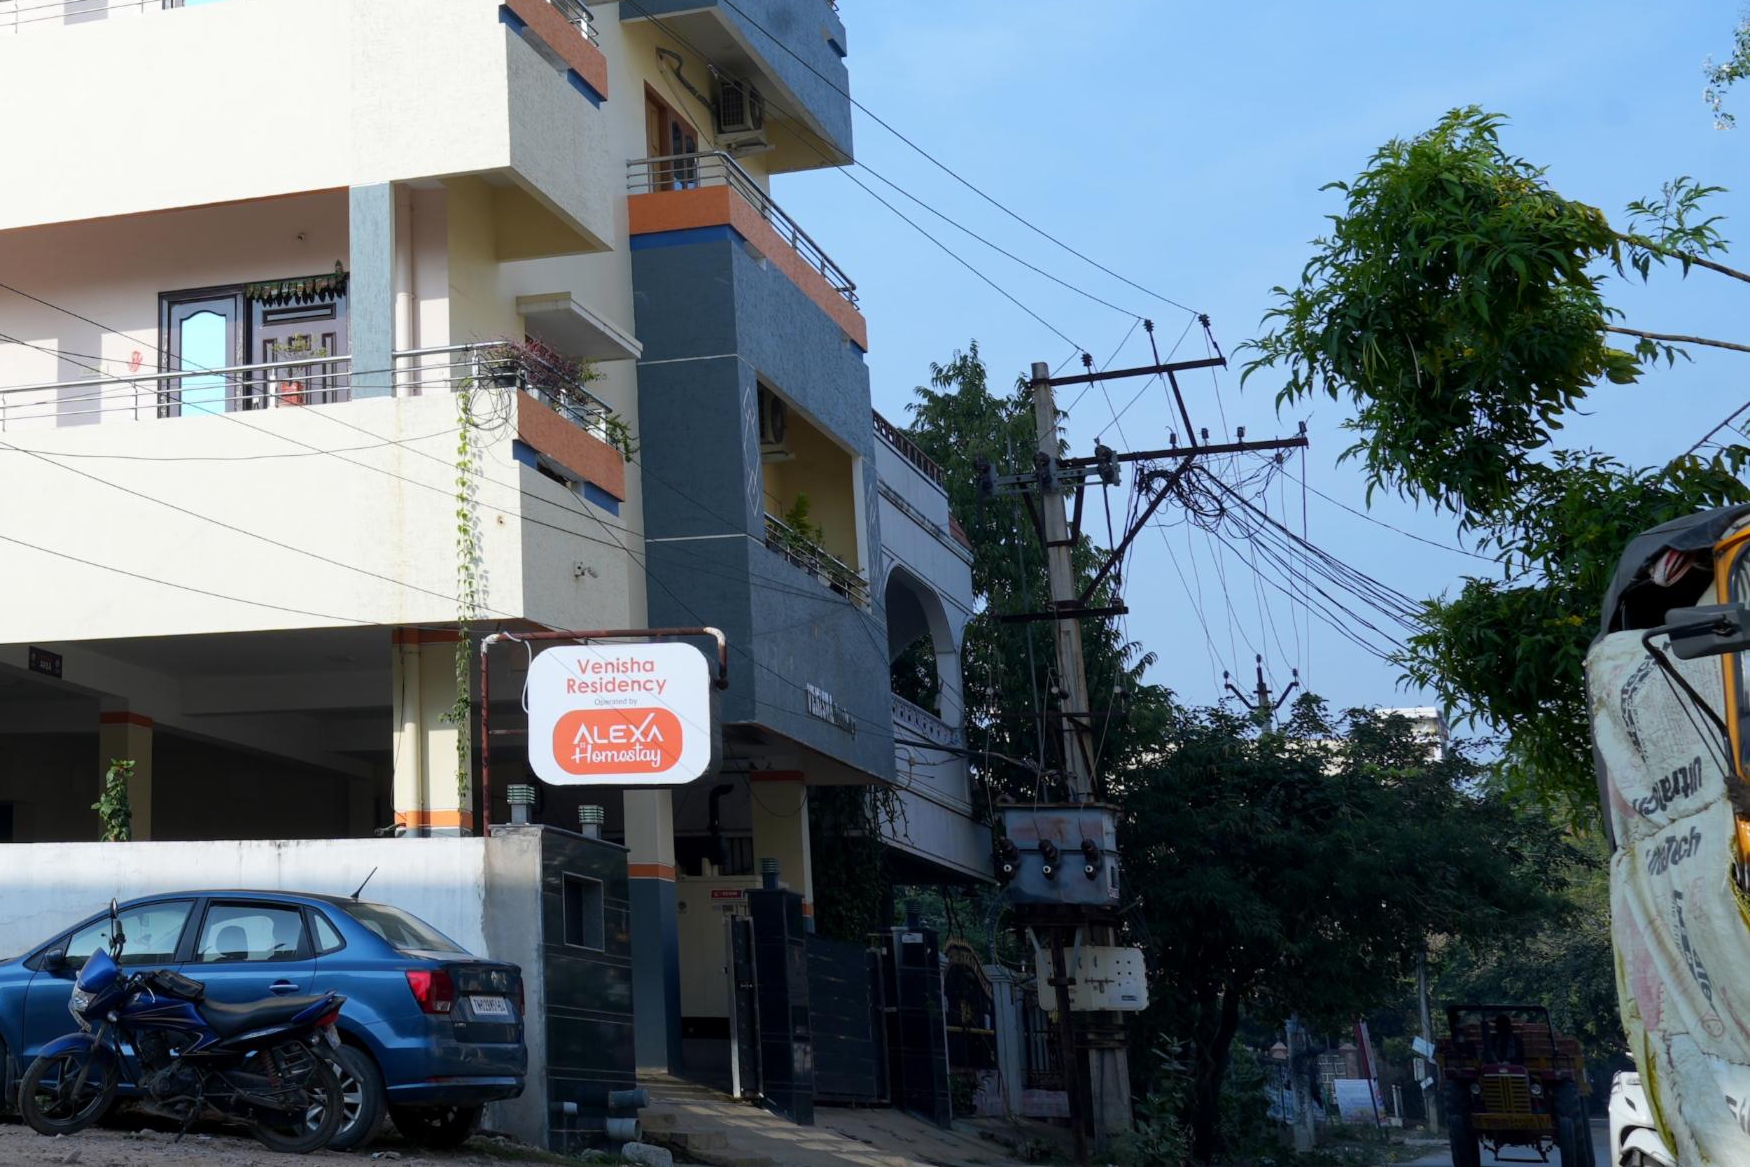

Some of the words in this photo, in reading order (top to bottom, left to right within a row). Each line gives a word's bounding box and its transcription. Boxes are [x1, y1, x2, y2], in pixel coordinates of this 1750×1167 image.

[577, 657, 655, 675] Venisha
[566, 676, 667, 695] Residency
[594, 698, 627, 706] Operated
[628, 698, 638, 706] by
[573, 712, 664, 744] ALEXA
[571, 742, 661, 768] Homestay
